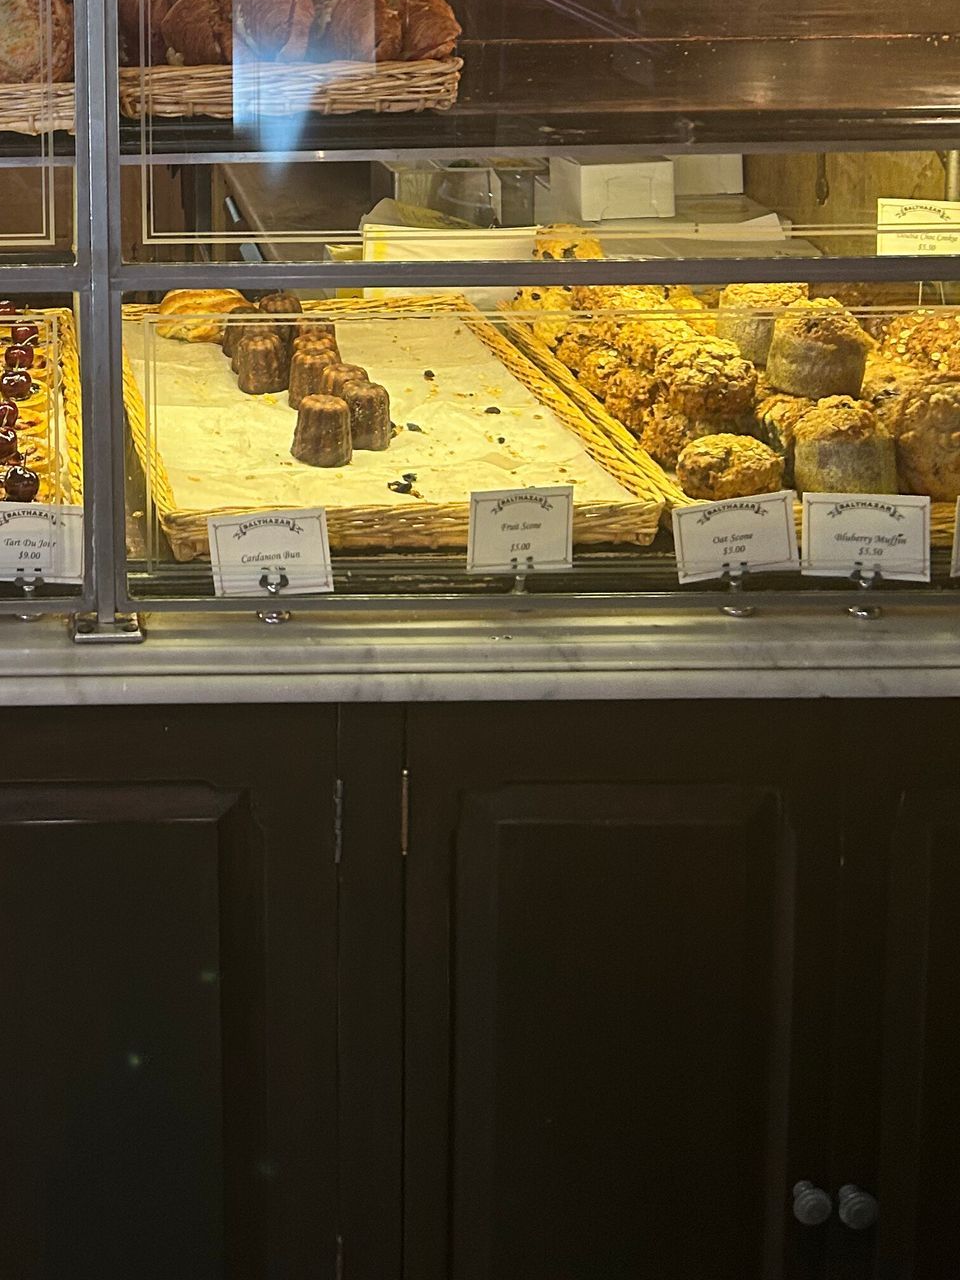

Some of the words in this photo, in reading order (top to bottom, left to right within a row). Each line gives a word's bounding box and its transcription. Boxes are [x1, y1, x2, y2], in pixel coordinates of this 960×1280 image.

[903, 205, 942, 213] BALTHAZAR
[501, 495, 544, 505] BALTHAZAR
[707, 503, 756, 516] BALTHAZAR
[839, 501, 893, 513] BALTHAZAR
[243, 518, 291, 530] BALTHAZAR
[520, 522, 541, 531] Scone
[4, 538, 21, 548] Tart
[23, 538, 37, 548] Du
[712, 535, 728, 544] Oat
[730, 532, 754, 543] Scone
[874, 534, 907, 547] Muffin
[18, 551, 41, 560] $9.00
[283, 551, 301, 560] Bun
[722, 545, 746, 556] $5.00
